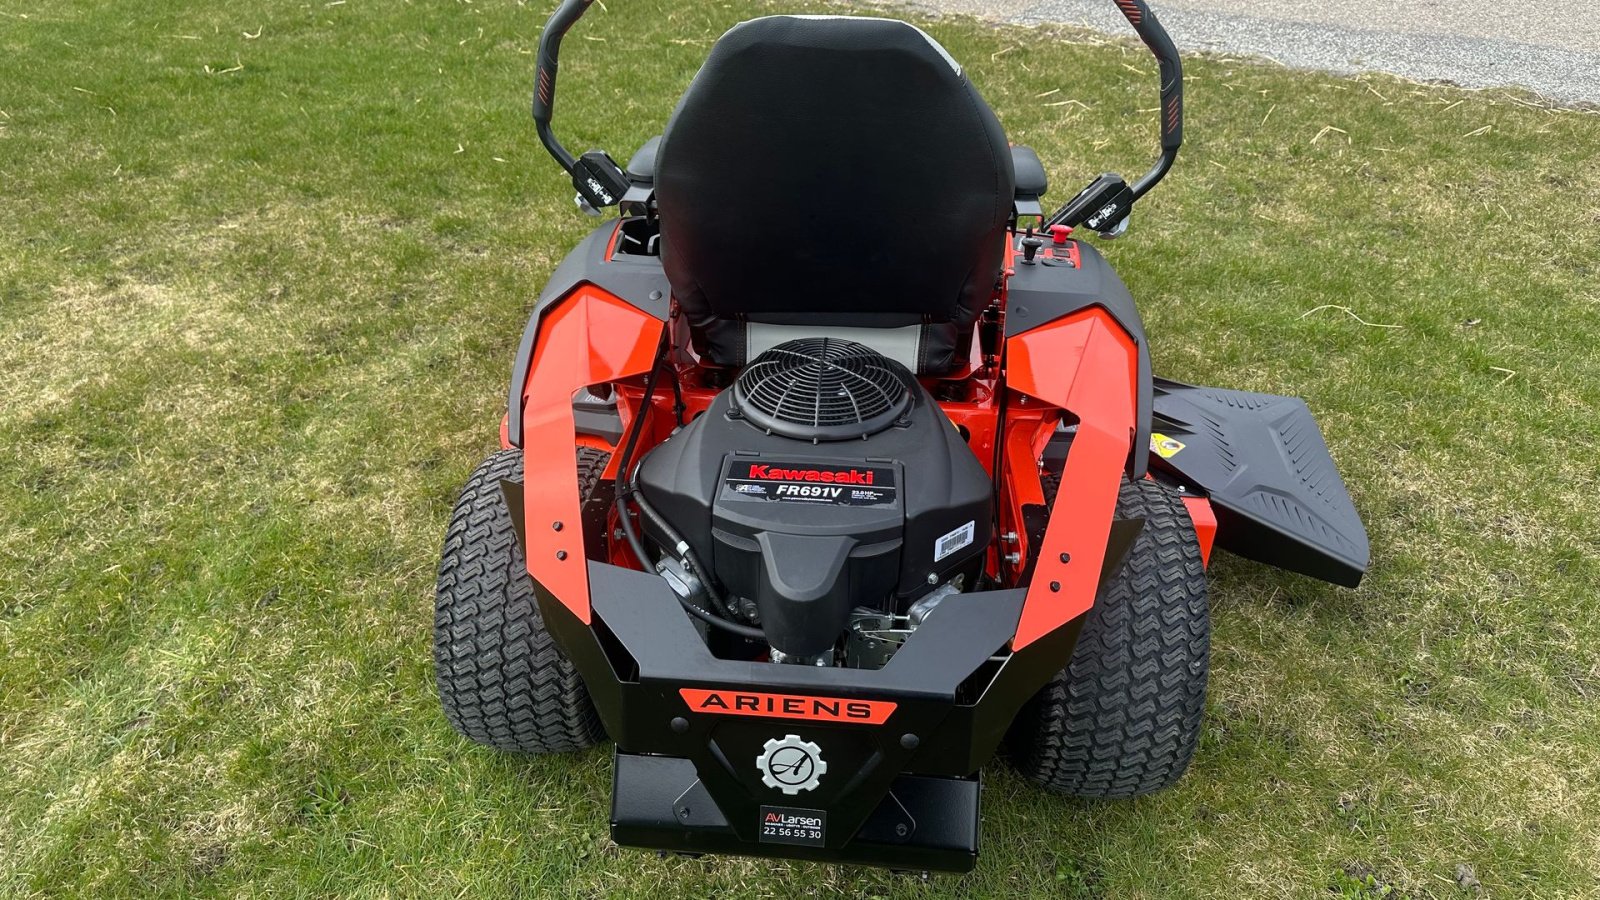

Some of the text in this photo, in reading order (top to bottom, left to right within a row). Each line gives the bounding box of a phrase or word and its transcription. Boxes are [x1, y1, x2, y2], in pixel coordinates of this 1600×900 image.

[749, 464, 874, 485] Kawasaki
[776, 485, 842, 498] FR691V
[700, 693, 871, 719] ARIENS
[764, 827, 822, 839] 22 56 55 30
